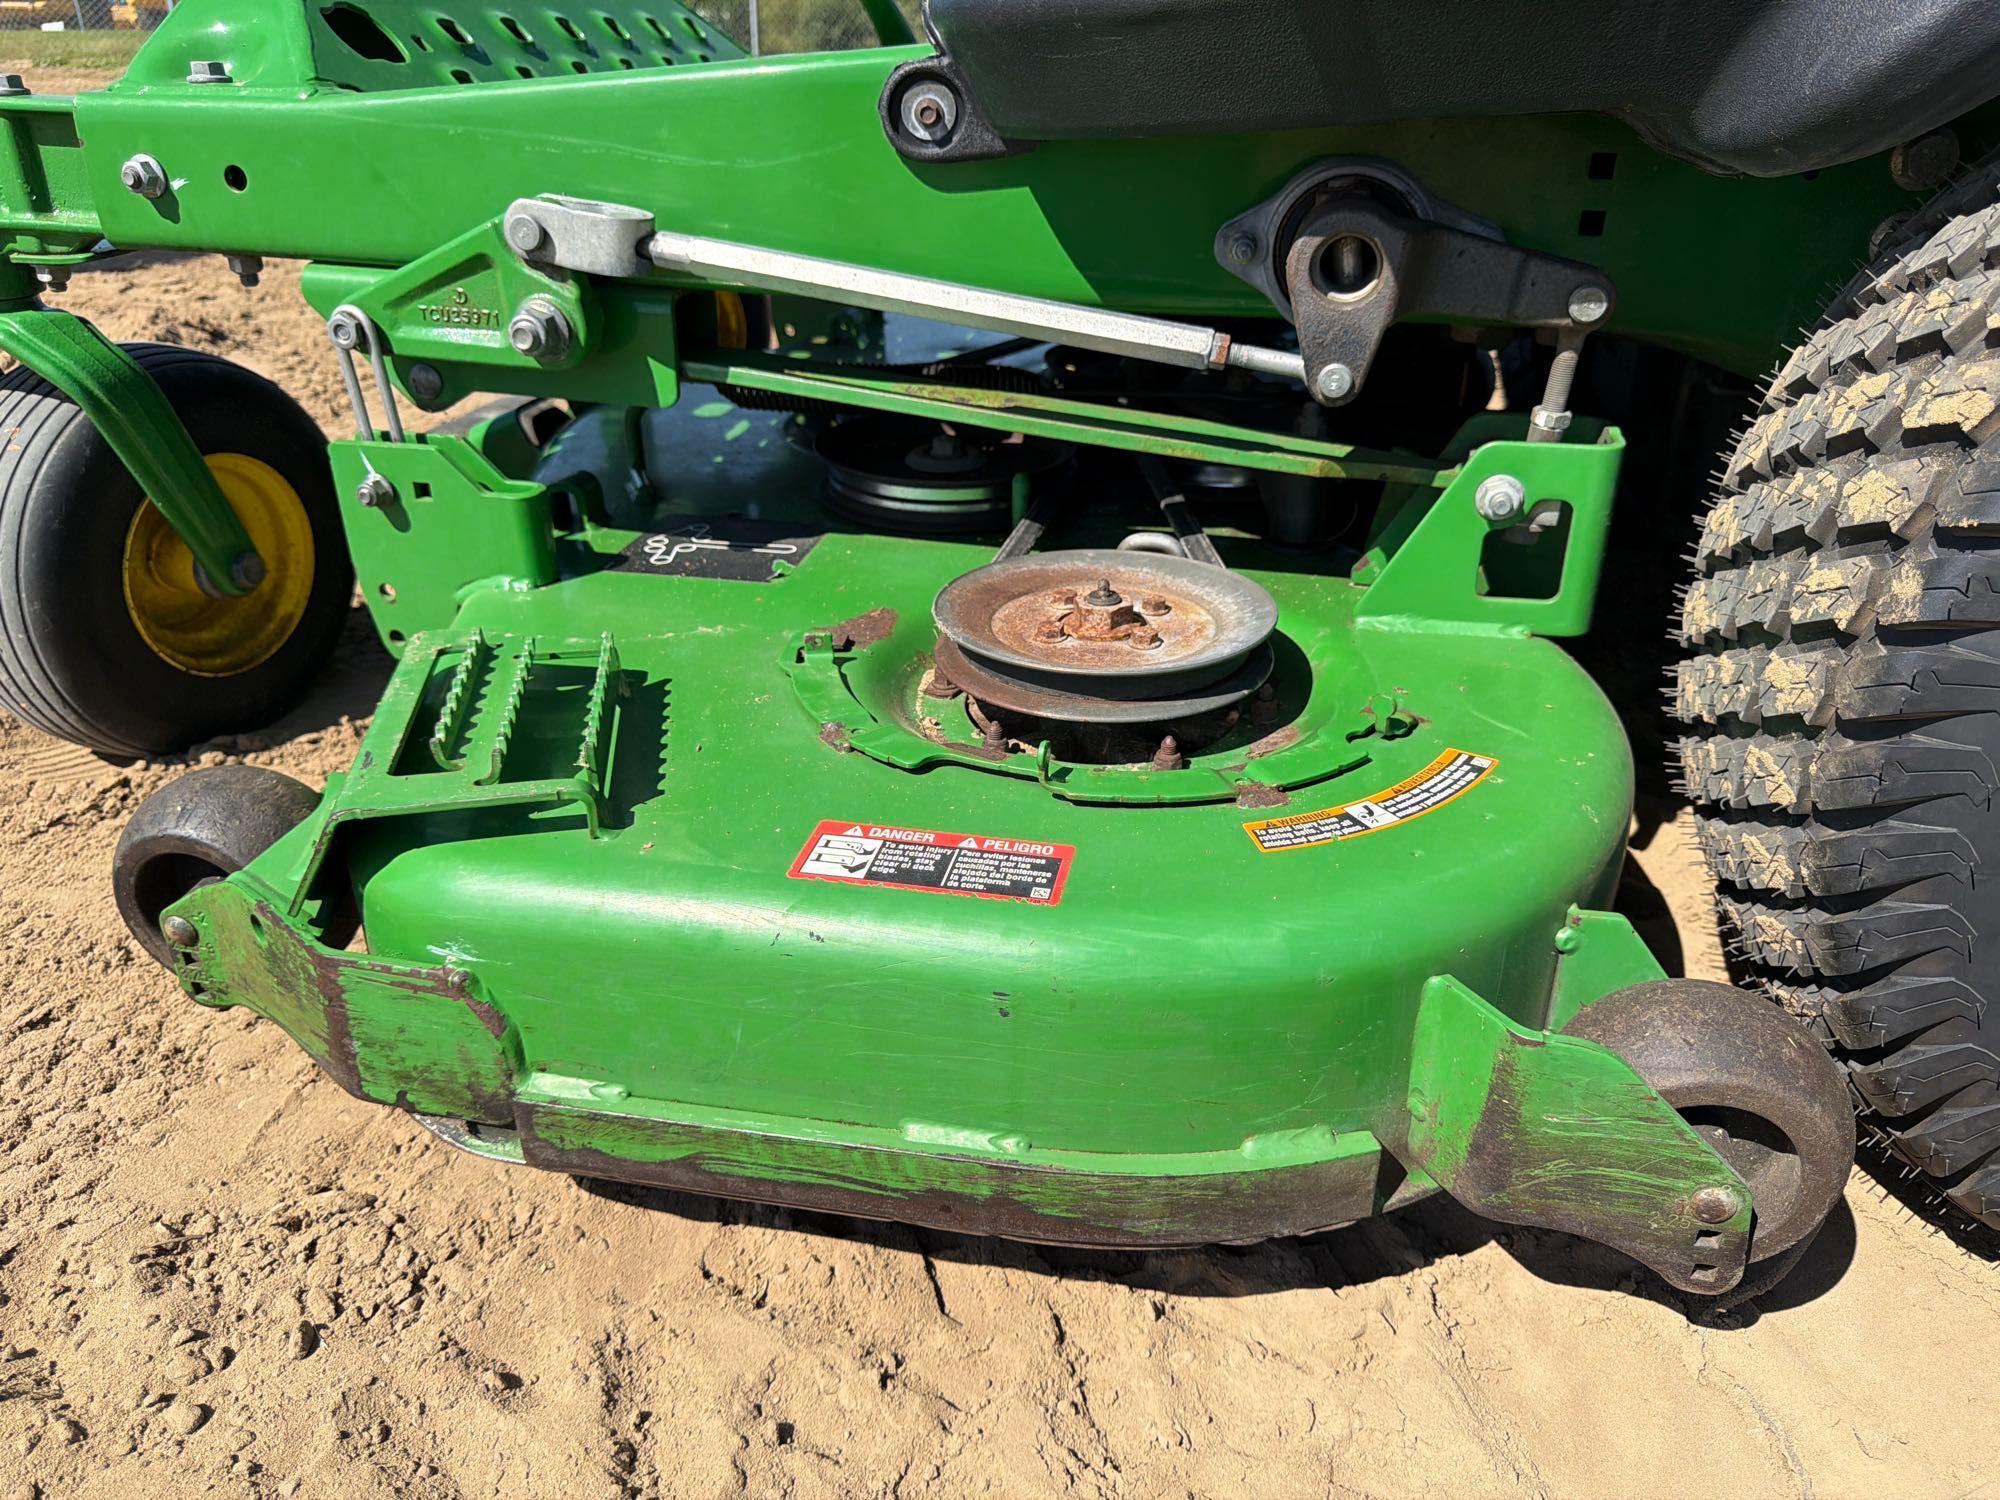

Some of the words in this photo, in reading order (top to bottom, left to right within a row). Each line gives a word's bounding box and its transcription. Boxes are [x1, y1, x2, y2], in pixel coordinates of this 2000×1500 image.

[418, 304, 500, 326] TCU25971
[1278, 810, 1331, 827] WARNING
[868, 827, 936, 843] DANGER
[1254, 828, 1266, 836] To
[898, 844, 924, 852] avoid
[926, 845, 953, 855] injury
[904, 849, 942, 860] rotating
[983, 839, 1055, 856] PELIGRO
[878, 853, 912, 864] blades,
[915, 857, 935, 866] stay
[957, 856, 999, 867] causadas
[1000, 860, 1016, 869] por
[1017, 861, 1031, 870] las
[960, 849, 981, 858] Para
[983, 852, 1008, 860] evitar
[1009, 854, 1046, 864] lesiones
[872, 866, 898, 874] edge.
[901, 861, 911, 869] of
[912, 863, 935, 871] deck
[955, 861, 997, 873] cuchillas,
[999, 867, 1053, 879] mantenerse
[949, 873, 959, 881] la
[960, 874, 1011, 887] plataforma
[952, 868, 988, 878] alejado
[989, 870, 1004, 880] del
[1006, 873, 1033, 882] borde
[1035, 876, 1047, 884] de
[960, 882, 987, 890] corte.
